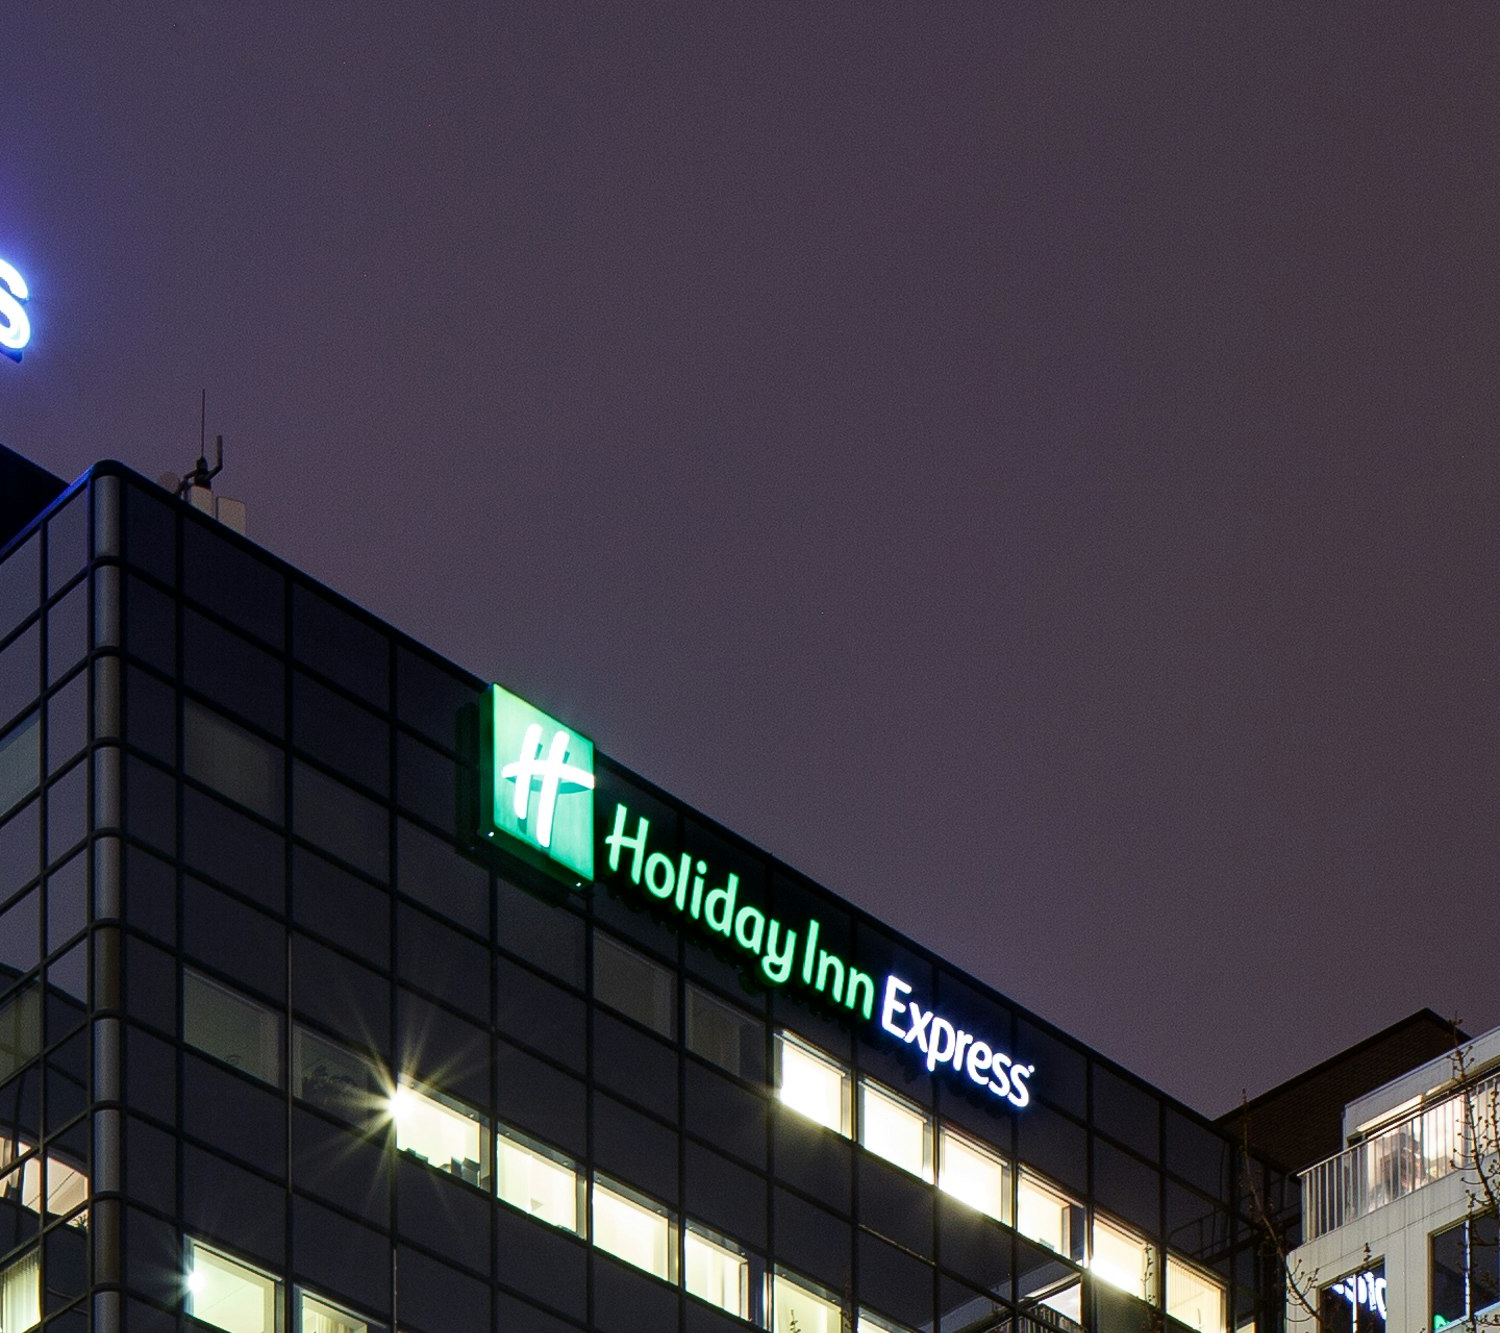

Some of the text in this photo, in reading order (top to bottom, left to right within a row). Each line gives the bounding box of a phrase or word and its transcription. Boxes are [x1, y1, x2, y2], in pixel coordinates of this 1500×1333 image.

[605, 803, 1032, 1108] Holiday Inn Express
